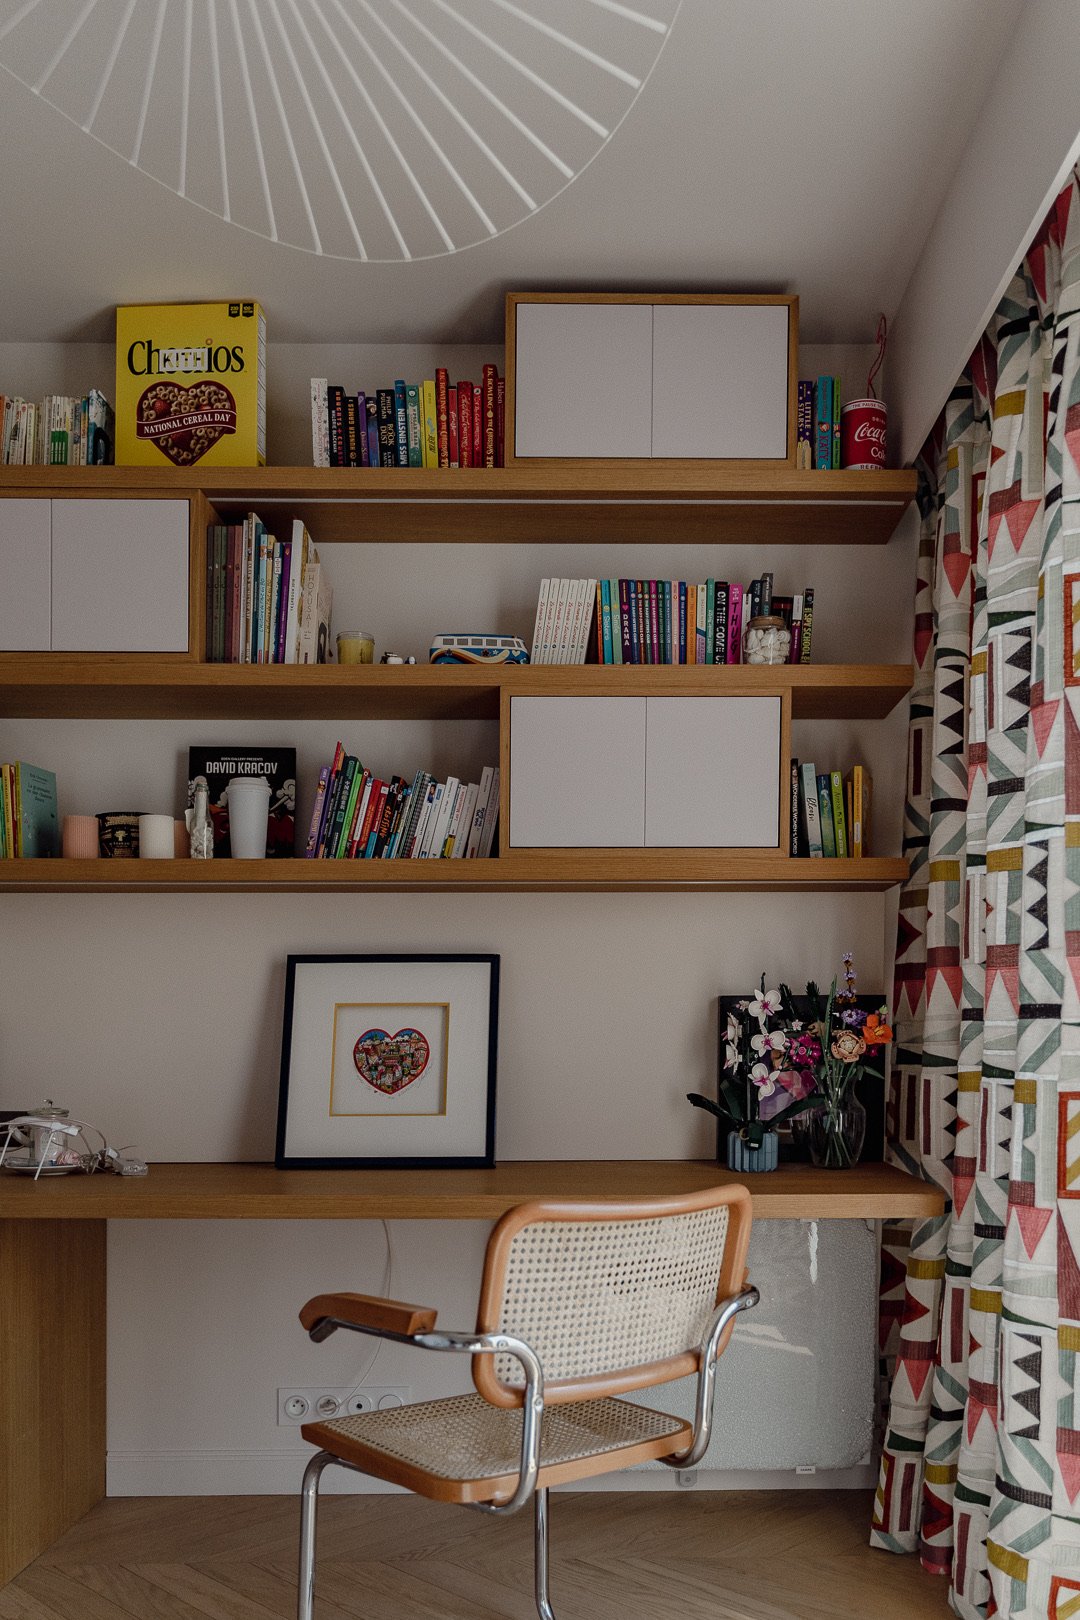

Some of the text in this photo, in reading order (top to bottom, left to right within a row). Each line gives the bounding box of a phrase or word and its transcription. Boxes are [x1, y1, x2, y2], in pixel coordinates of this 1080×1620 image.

[163, 352, 205, 368] KITH
[143, 414, 231, 434] NATIONAL CEREAL DAY
[398, 408, 406, 443] EINSTEIN
[819, 436, 828, 460] KATY
[306, 576, 315, 628] HOKUSAI
[717, 591, 726, 605] ON
[716, 607, 726, 624] THE
[804, 613, 812, 627] SPY
[716, 626, 724, 652] COME
[731, 602, 739, 655] THUG
[802, 628, 811, 655] SCHOOL
[206, 762, 278, 774] DAVID KRACOV
